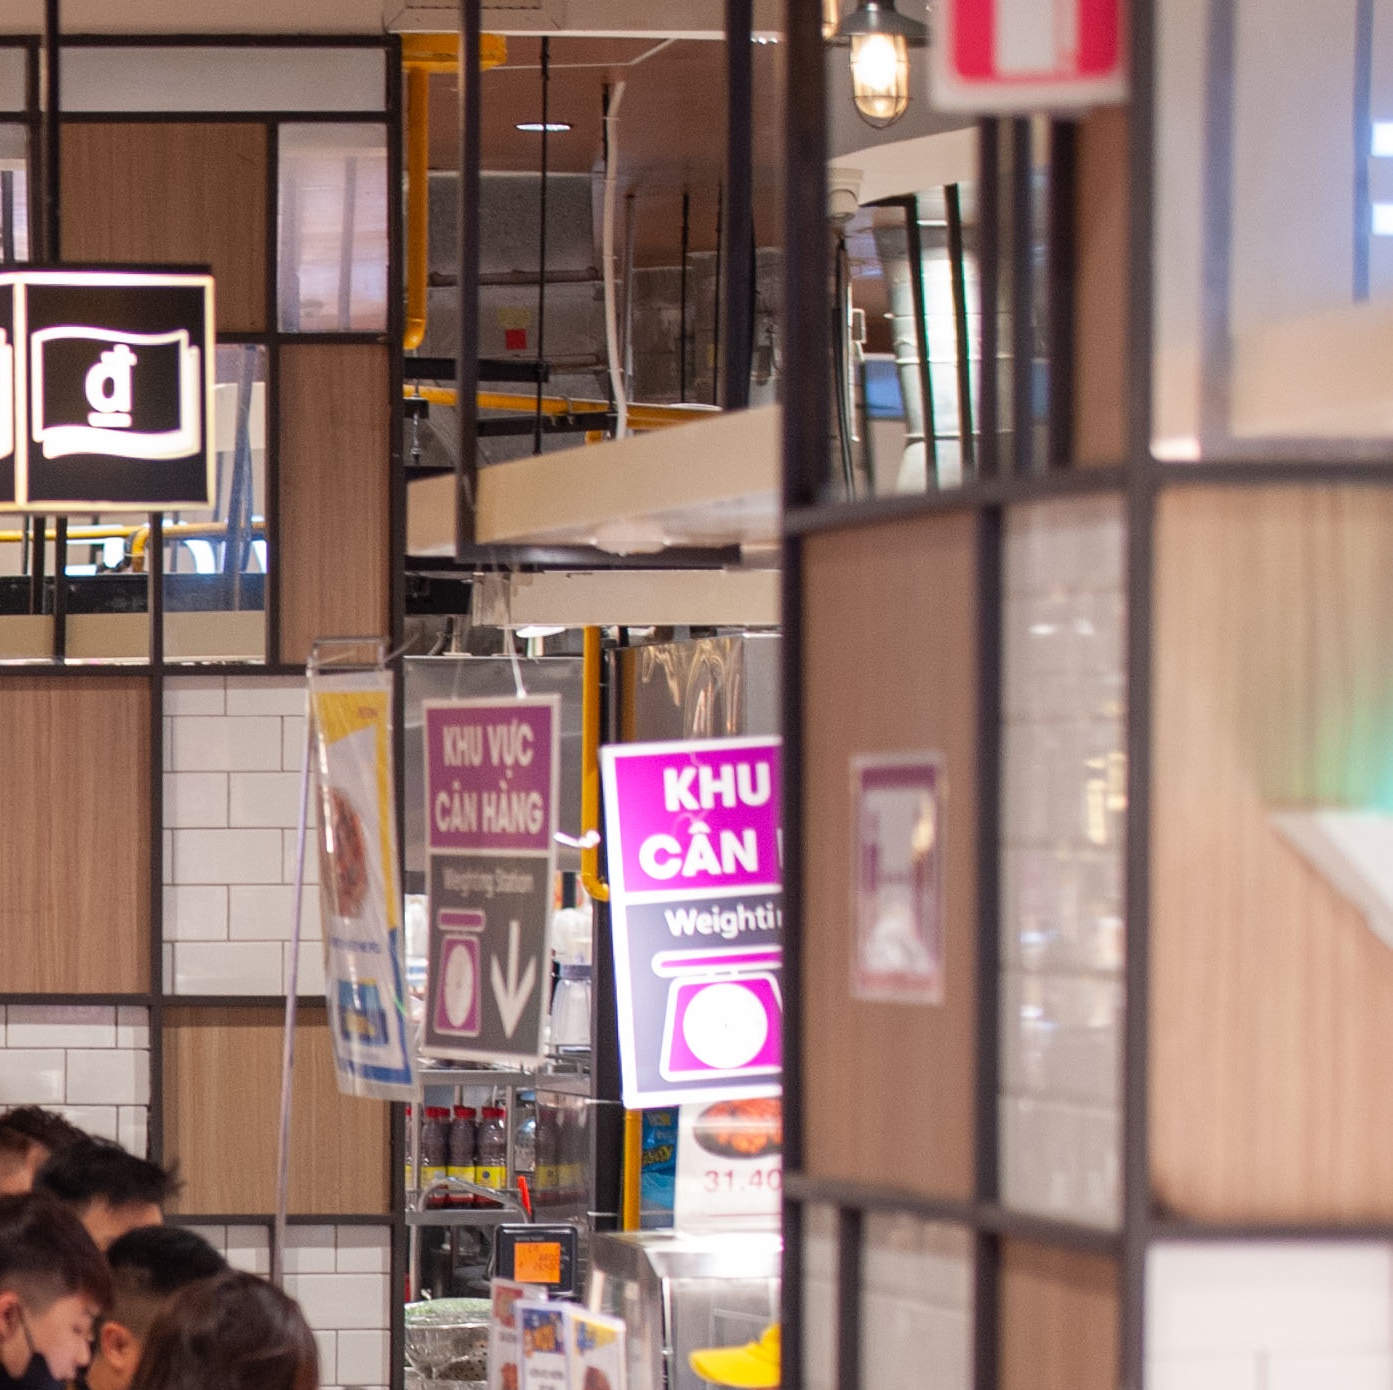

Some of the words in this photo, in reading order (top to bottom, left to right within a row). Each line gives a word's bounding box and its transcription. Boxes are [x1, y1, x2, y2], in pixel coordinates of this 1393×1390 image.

[442, 724, 483, 767] KHU
[486, 717, 535, 779] VỰC
[481, 779, 544, 835] HÀNG
[662, 761, 772, 813] KHU
[638, 820, 759, 881] CÂN
